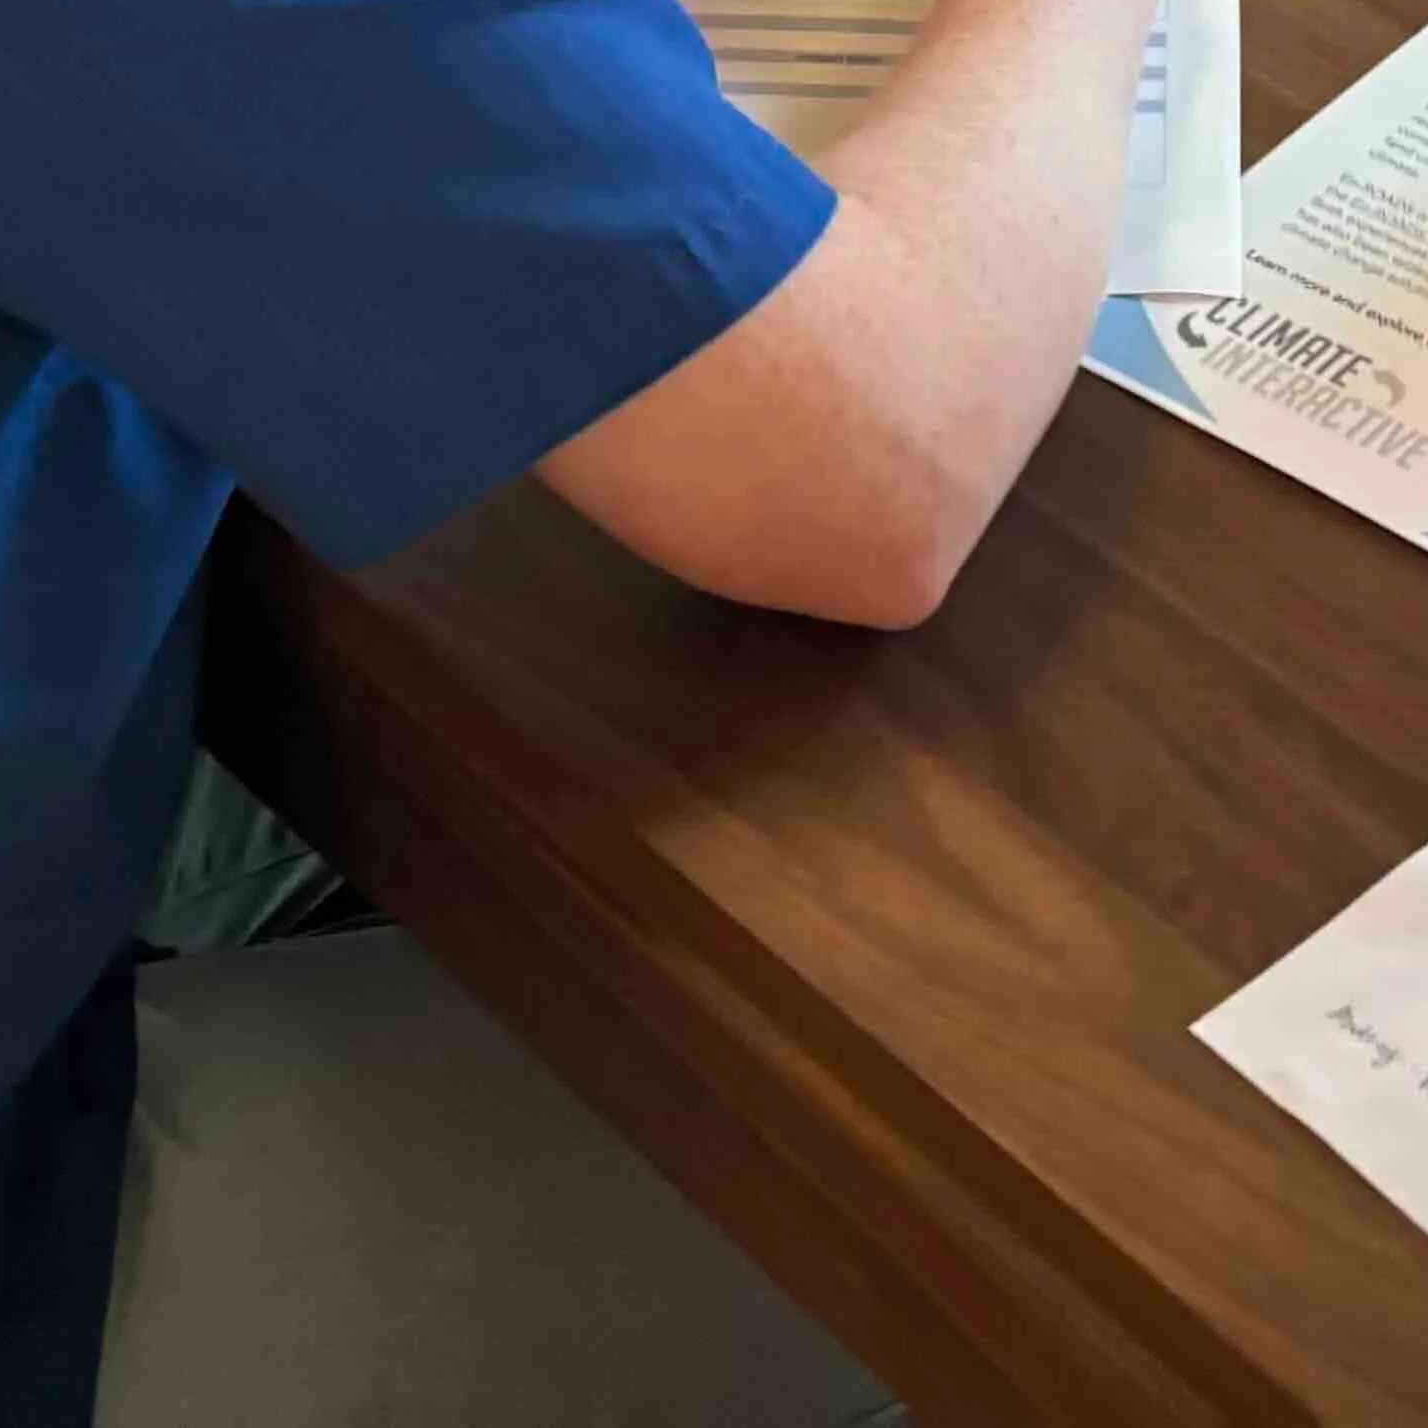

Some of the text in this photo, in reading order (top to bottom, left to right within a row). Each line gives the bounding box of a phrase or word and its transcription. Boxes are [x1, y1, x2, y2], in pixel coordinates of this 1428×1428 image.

[1244, 248, 1288, 276] Learn
[1331, 293, 1368, 314] and
[1205, 296, 1374, 390] CLIMATE
